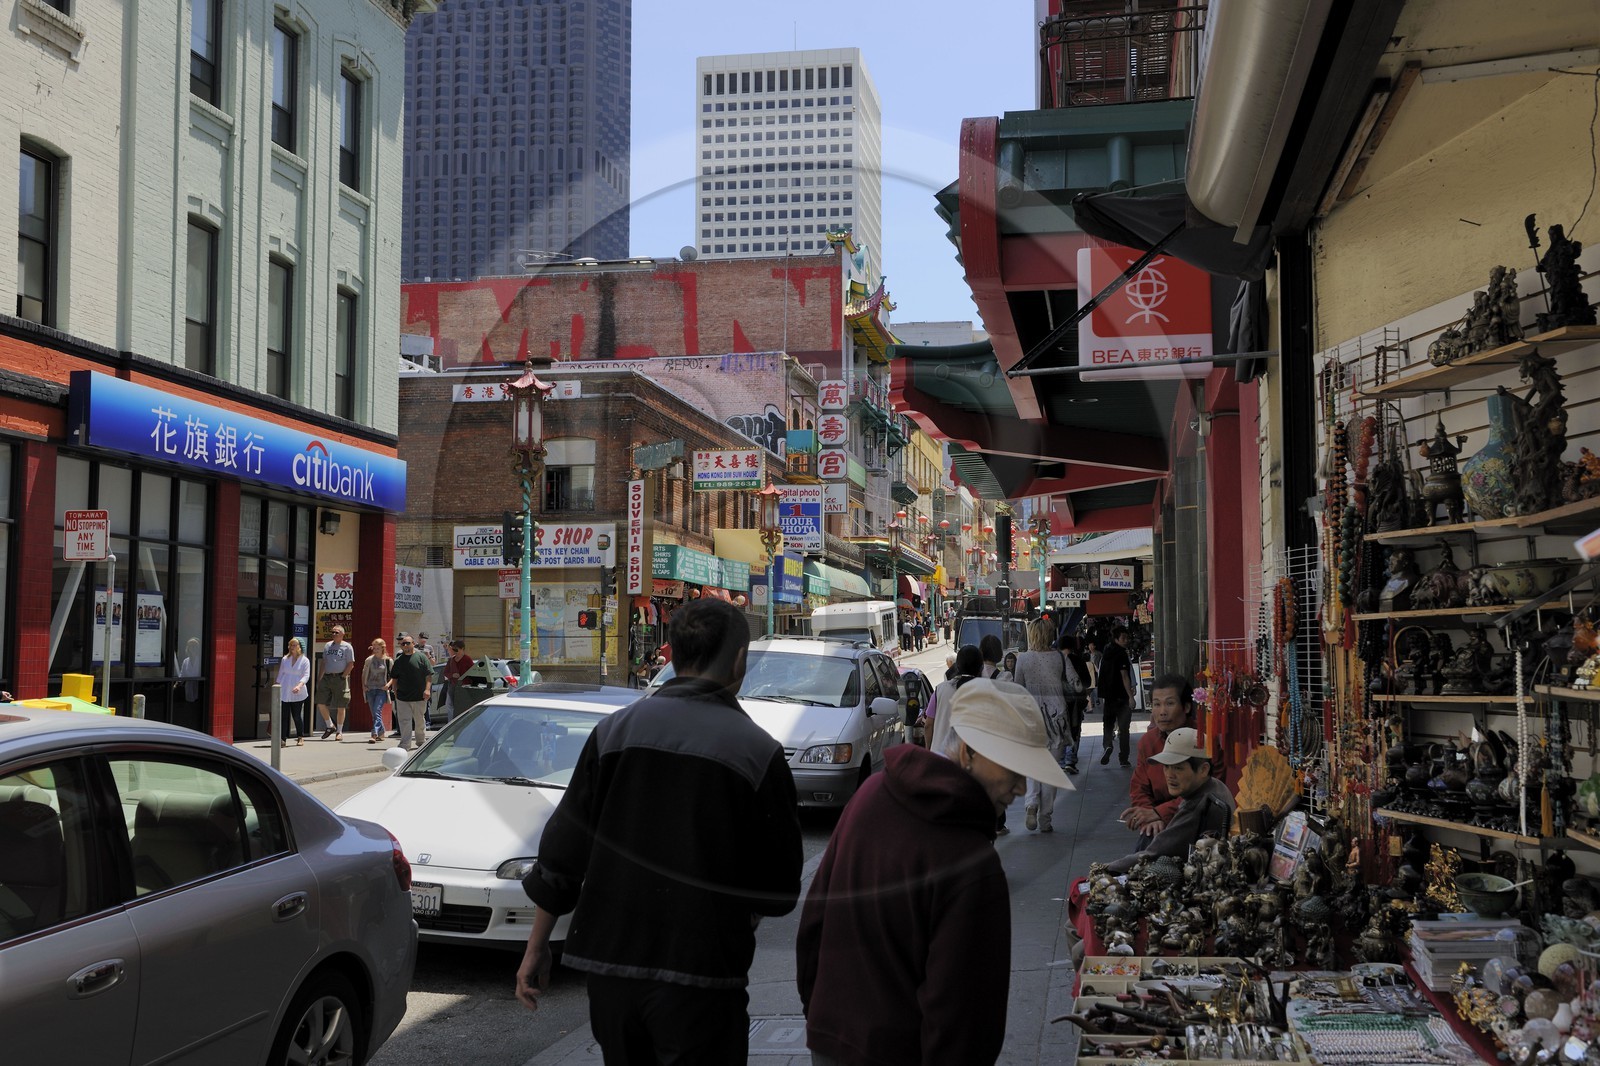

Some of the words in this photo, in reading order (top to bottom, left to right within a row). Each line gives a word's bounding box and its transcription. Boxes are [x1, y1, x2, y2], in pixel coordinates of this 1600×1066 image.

[1092, 349, 1134, 364] BEA
[1137, 347, 1202, 361] 東亞銀行
[819, 383, 846, 476] 萬壽宮
[151, 406, 265, 475] 花旗銀行
[292, 441, 375, 501] citibank
[697, 472, 710, 480] HONG
[711, 471, 723, 479] KONG
[742, 470, 758, 478] HOUSE
[799, 488, 820, 498] photo
[789, 503, 805, 517] 1
[630, 484, 642, 553] SOUVENIR
[780, 517, 814, 526] HOUR
[66, 519, 78, 531] NO
[79, 521, 106, 530] STOPPING
[77, 532, 95, 541] ANY
[459, 535, 503, 546] JACKSO
[552, 527, 594, 546] SHOP
[76, 542, 95, 551] TIME
[555, 547, 568, 555] KEY
[570, 547, 590, 555] CHAIN
[464, 558, 485, 566] CABLE
[486, 557, 500, 566] CAR
[544, 557, 561, 565] POST
[563, 557, 585, 565] CARDS
[587, 556, 602, 564] MUG
[629, 556, 640, 590] SHOP
[316, 590, 331, 600] EY
[316, 600, 353, 610] TAURA
[393, 600, 422, 611] ESTAURANT
[411, 892, 437, 911] 301
